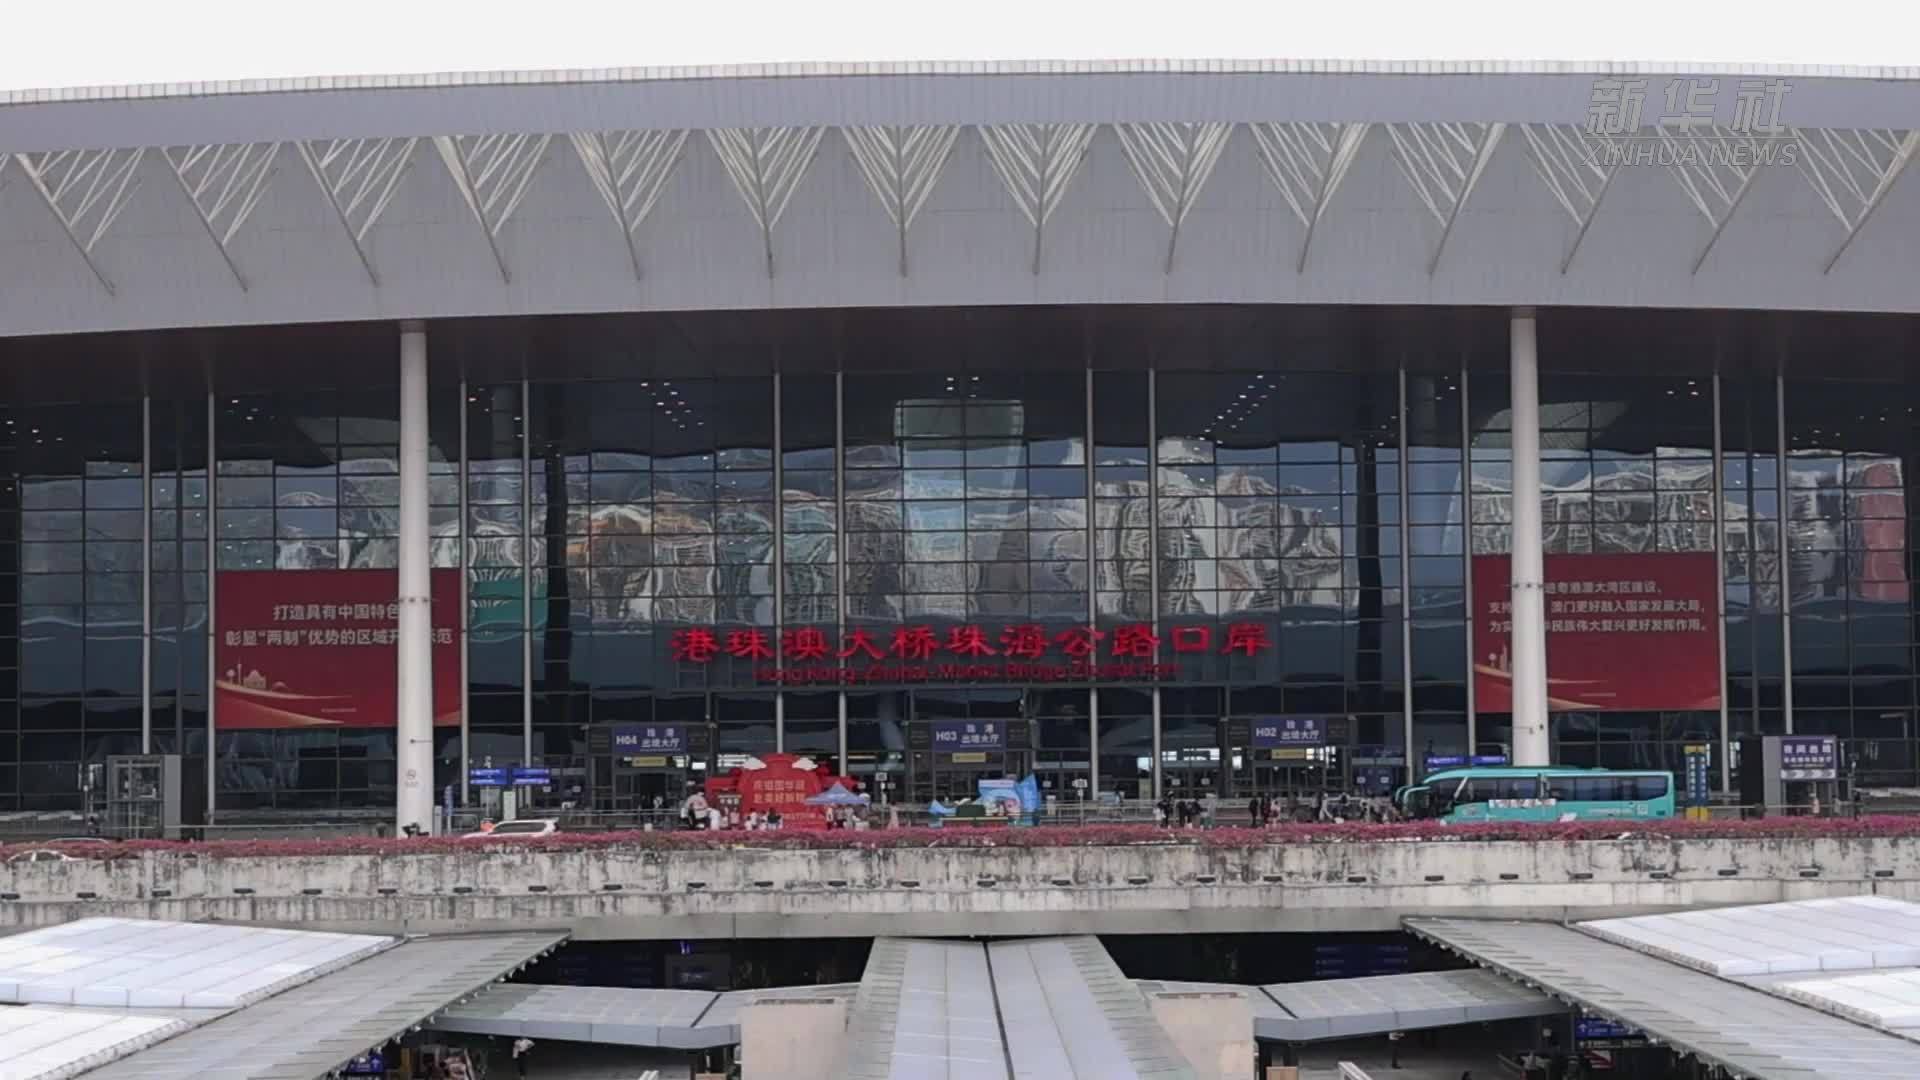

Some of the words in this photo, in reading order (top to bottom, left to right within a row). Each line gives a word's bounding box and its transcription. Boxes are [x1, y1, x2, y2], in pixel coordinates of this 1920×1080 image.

[225, 628, 453, 646] 彰显“两制”优势的区域开范
[668, 622, 1273, 663] 港珠澳大桥珠海公路口岸
[936, 731, 957, 741] H03
[1255, 727, 1277, 737] H02
[616, 735, 637, 745] H04
